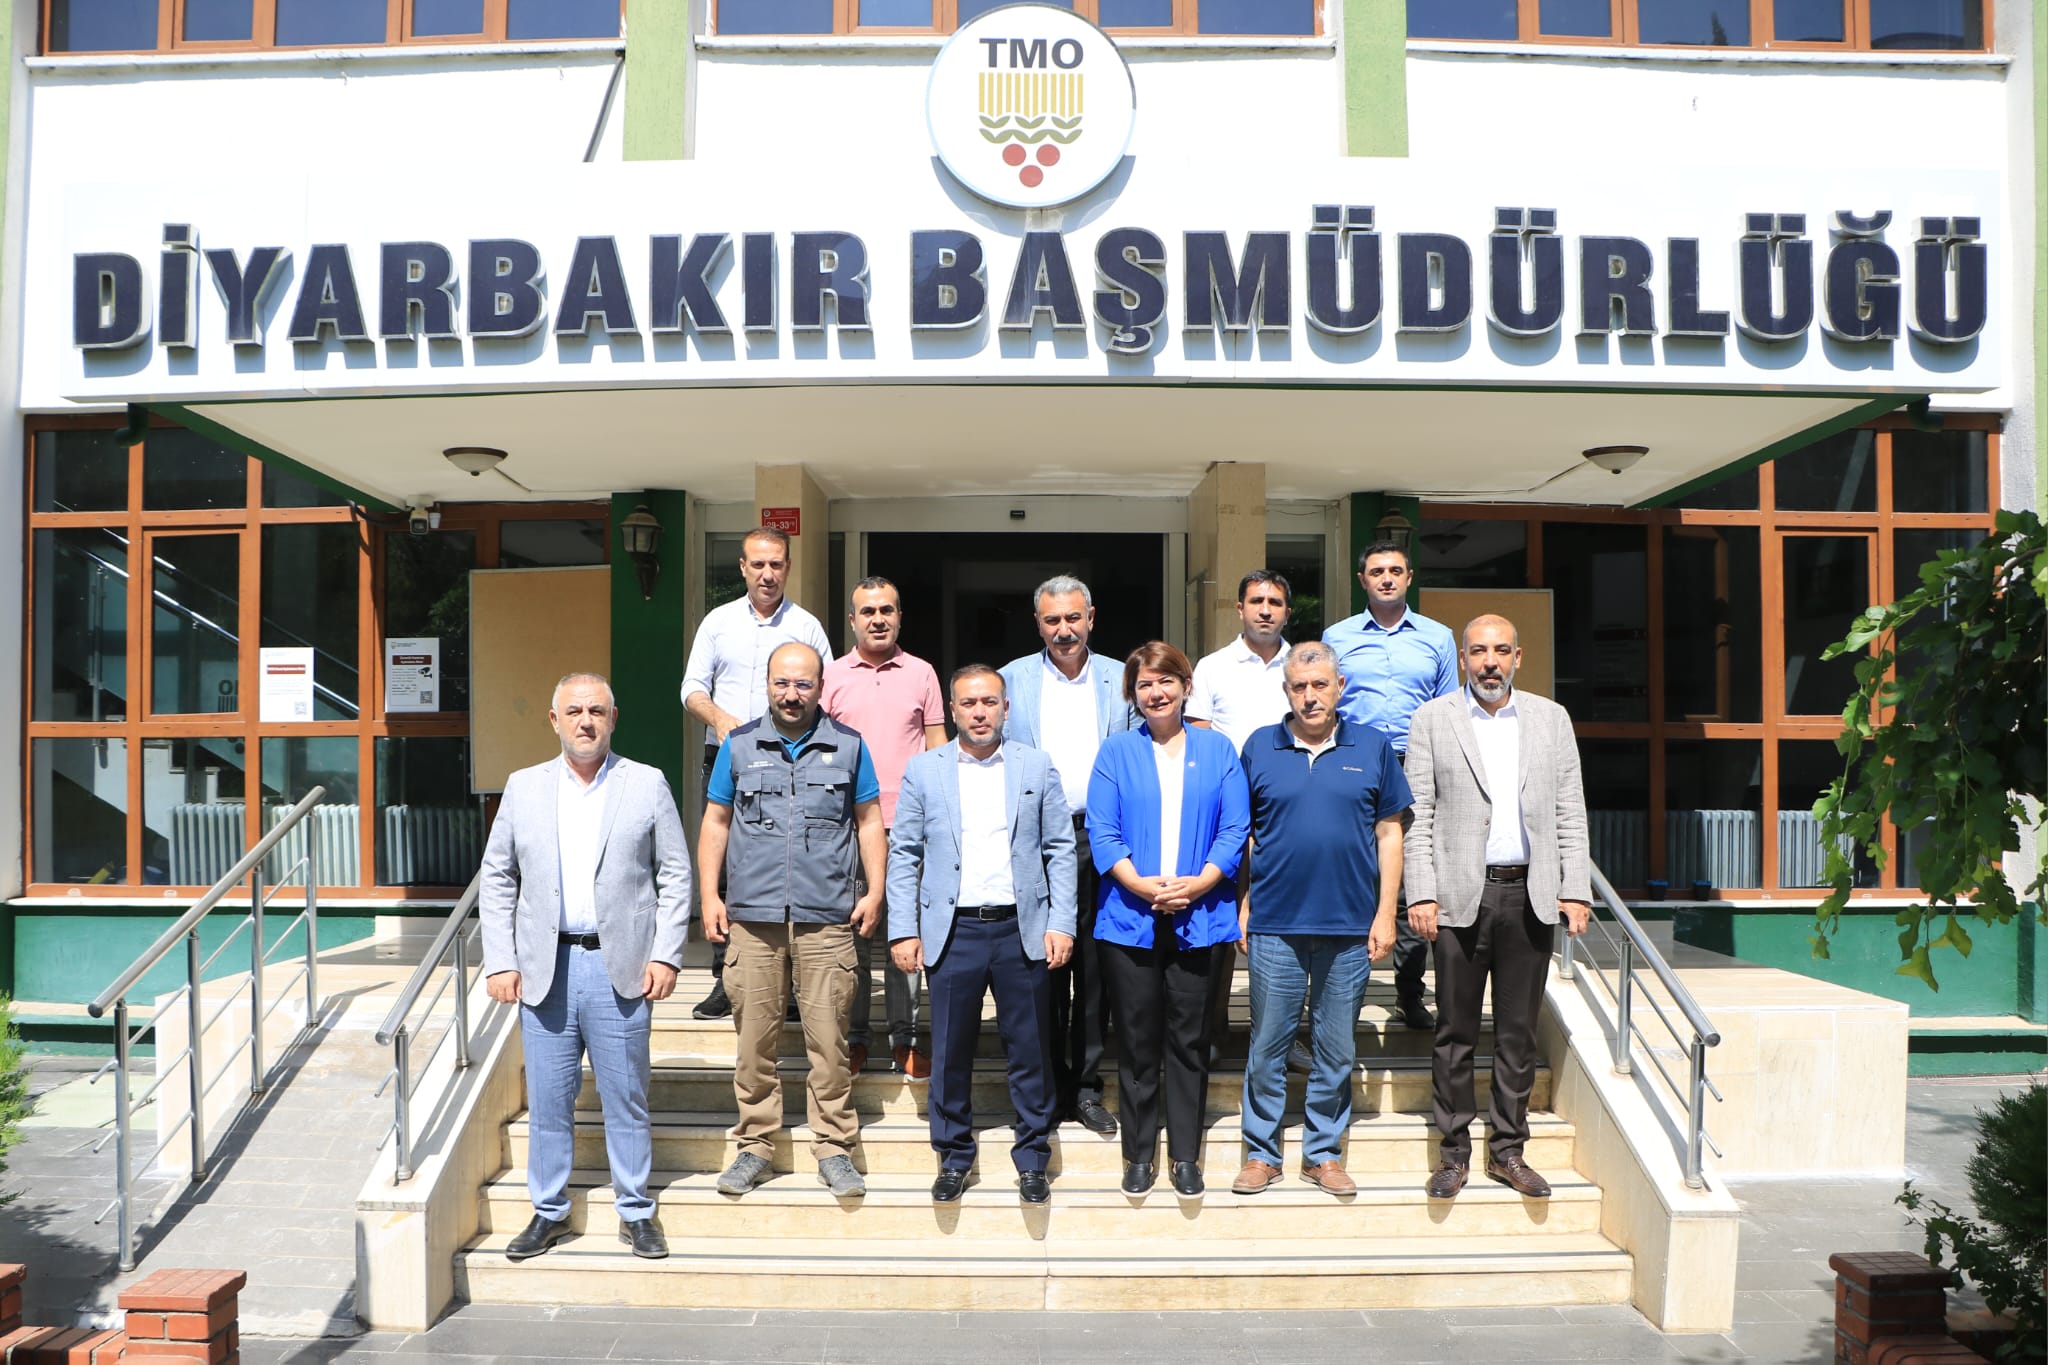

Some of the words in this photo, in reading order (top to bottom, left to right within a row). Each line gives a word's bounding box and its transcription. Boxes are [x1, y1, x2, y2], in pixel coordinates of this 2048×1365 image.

[979, 38, 1084, 69] TMO
[73, 223, 871, 350] DİYARBAKIR
[911, 205, 1987, 355] BAŞMÜDÜRLÜĞÜ
